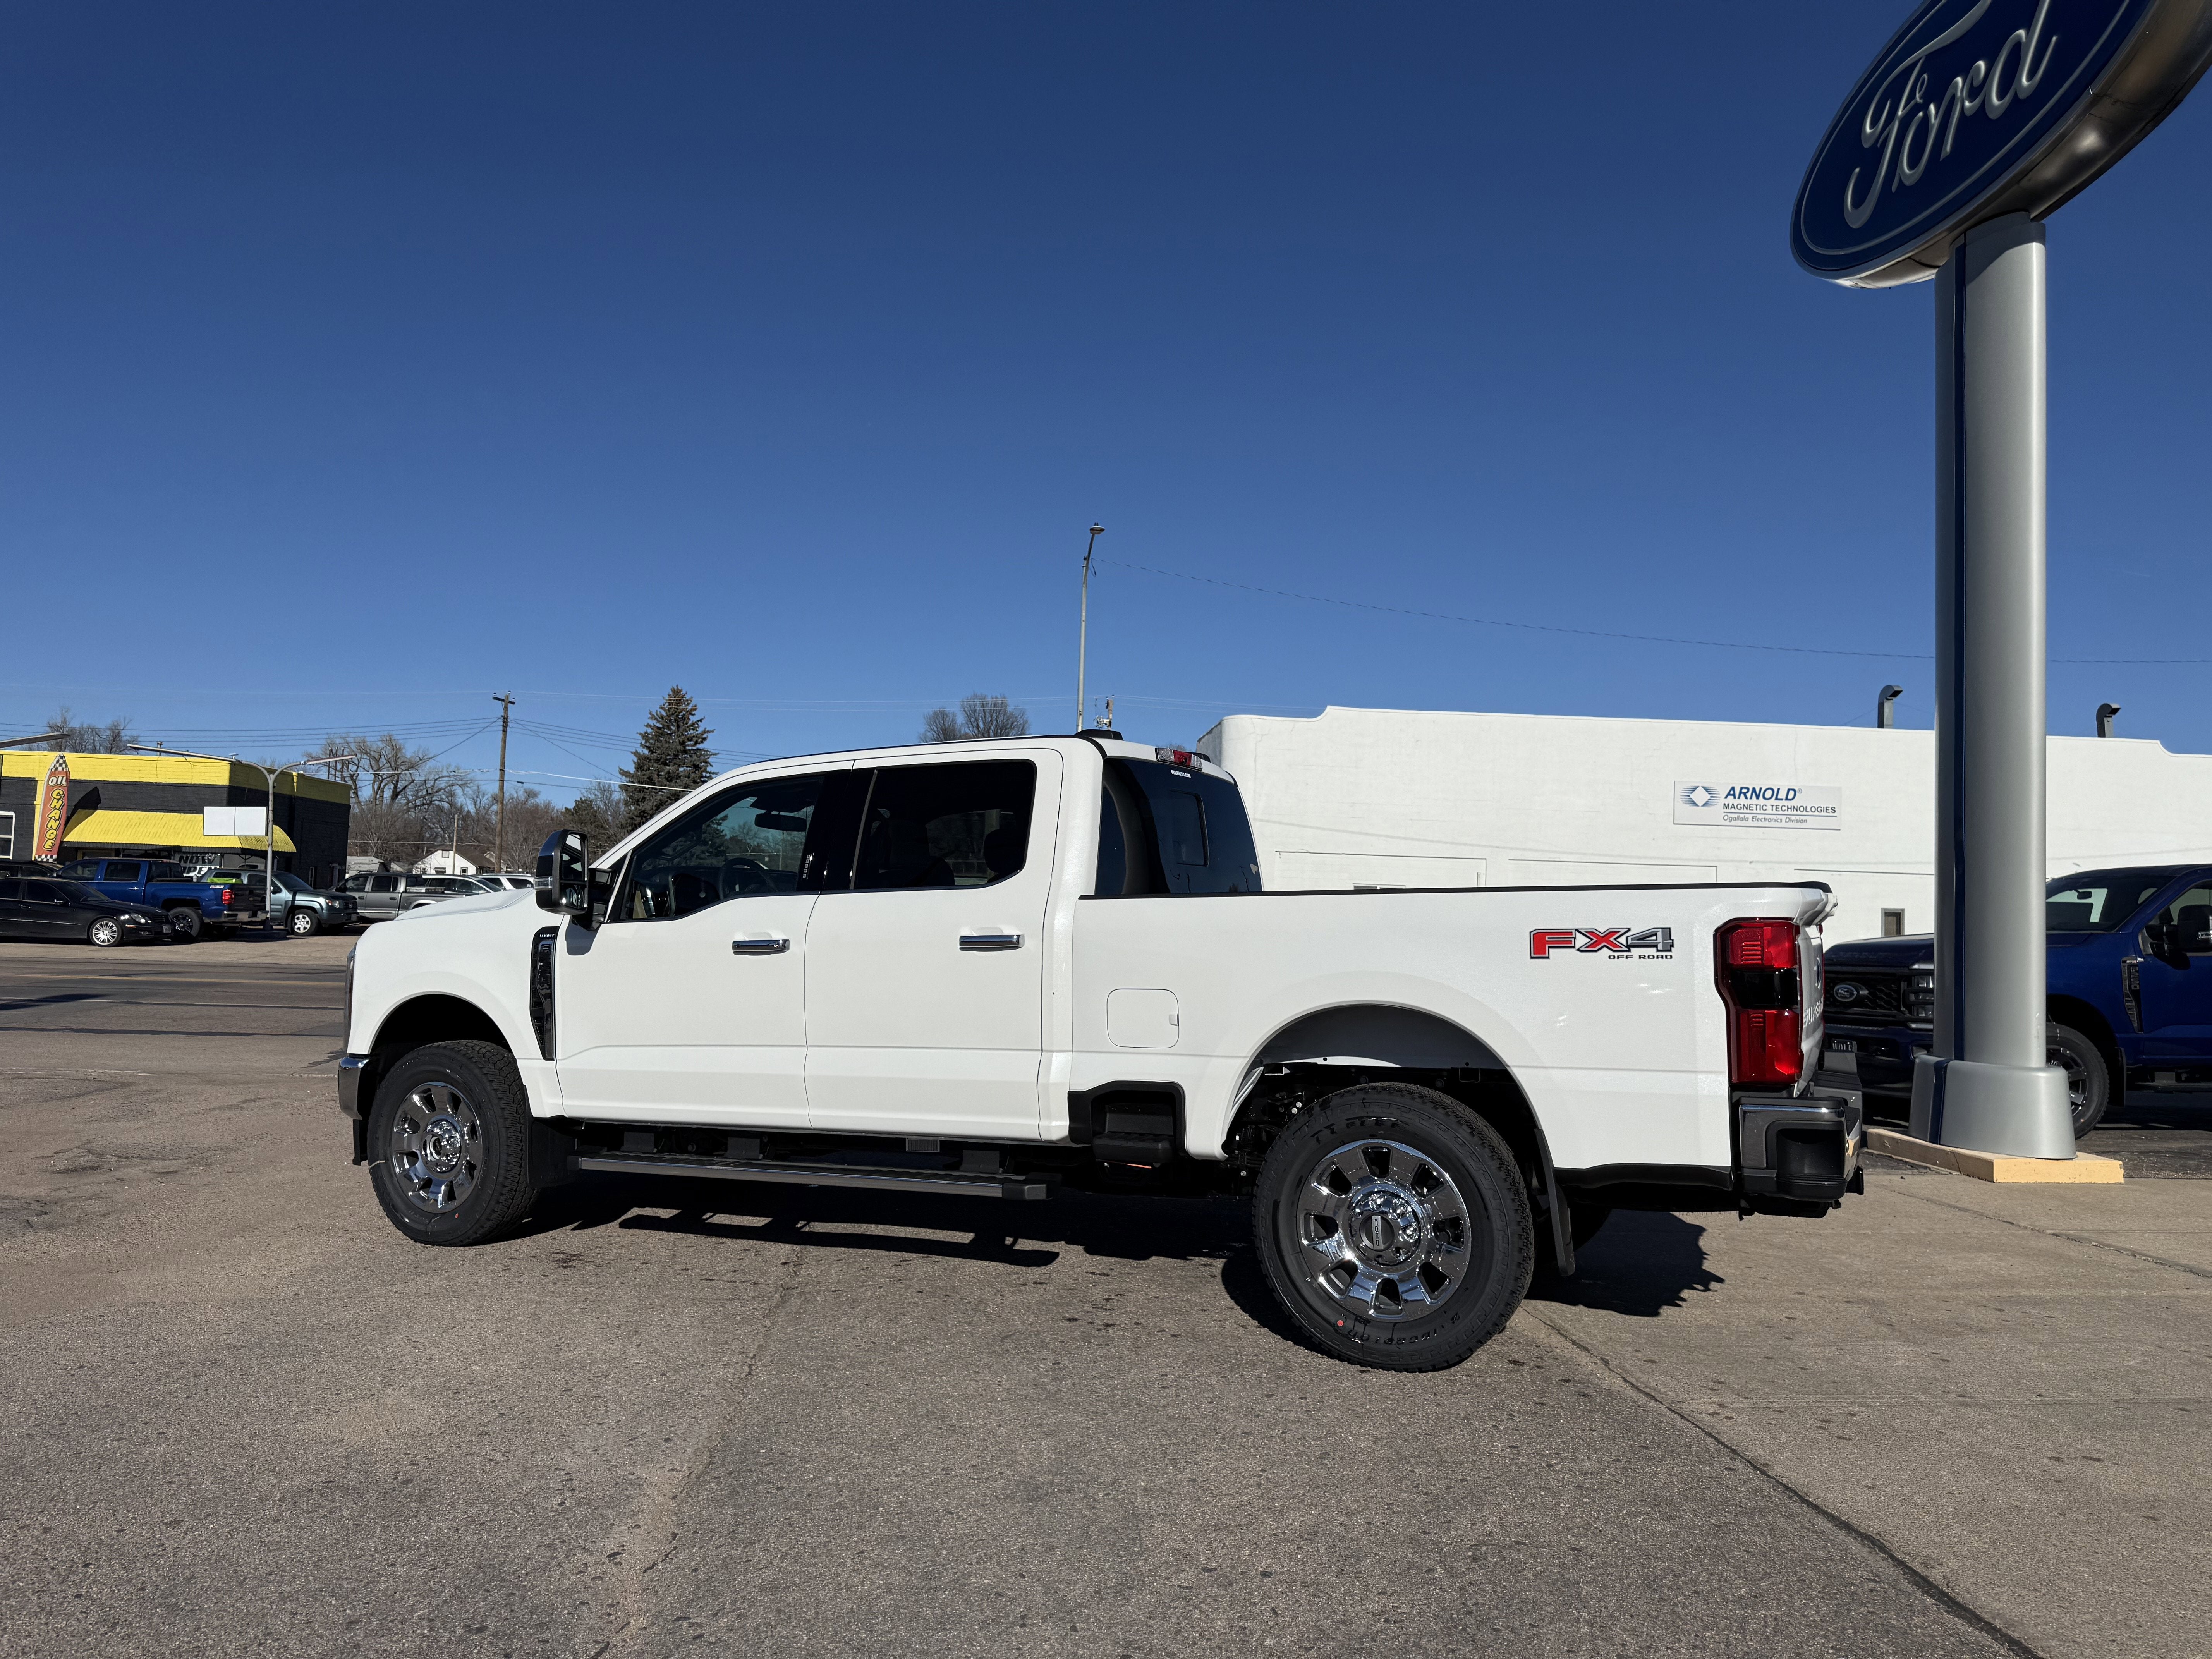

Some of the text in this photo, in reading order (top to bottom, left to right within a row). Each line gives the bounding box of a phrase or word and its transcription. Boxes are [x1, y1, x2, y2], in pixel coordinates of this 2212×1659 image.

[1843, 0, 2058, 229] Ford
[48, 776, 67, 786] OIL
[43, 788, 64, 851] CHANGE
[1723, 803, 1836, 813] MAGNETIC TECHNOLOGIES
[1530, 927, 1674, 959] FX4
